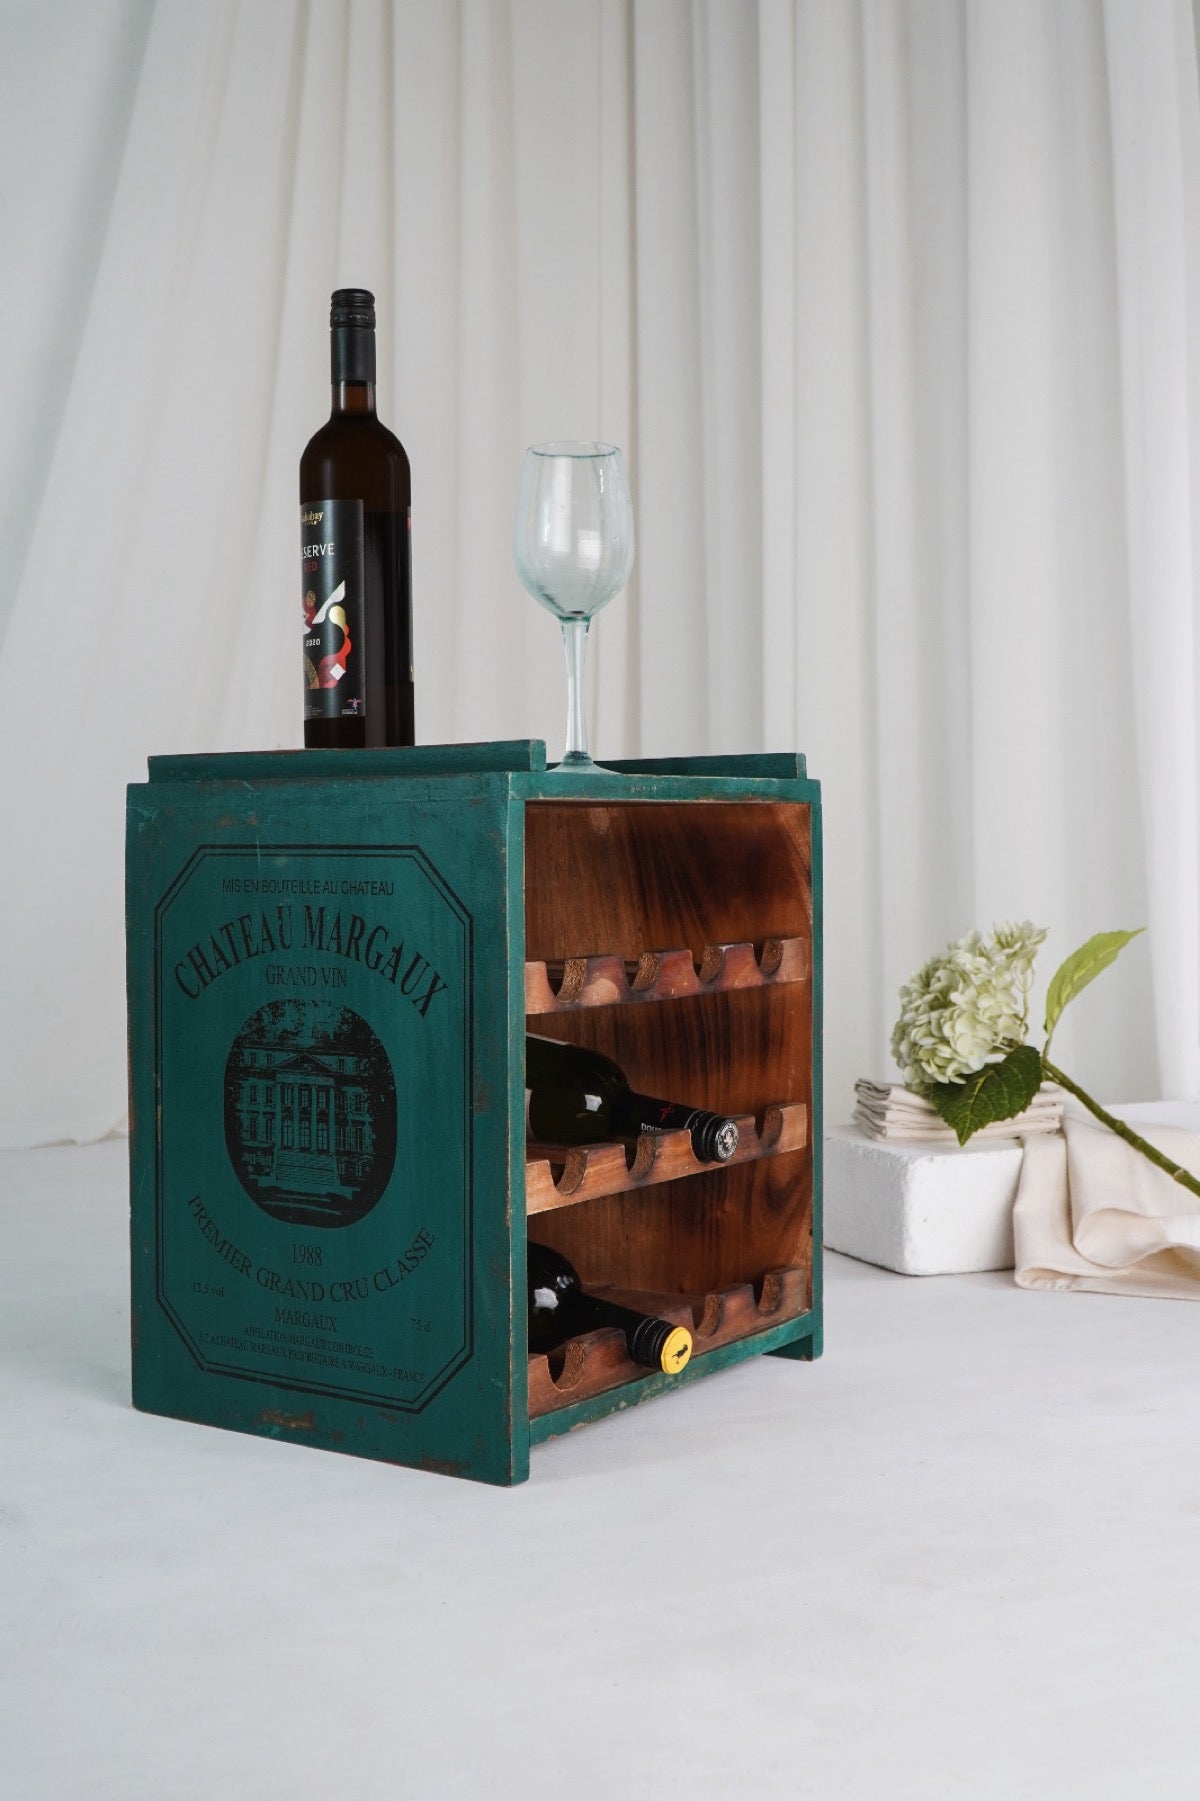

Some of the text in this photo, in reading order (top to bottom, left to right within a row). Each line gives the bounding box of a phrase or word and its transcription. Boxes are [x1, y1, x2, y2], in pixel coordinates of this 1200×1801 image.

[302, 543, 335, 559] SERVE
[222, 879, 394, 896] MIS EN BOUTEILLE AU CHATEAU
[173, 904, 448, 1018] CHATEAU MARGAUX
[264, 965, 346, 987] GRAND VIN
[187, 1195, 436, 1302] PREMIER GRAND CRU CLASSE
[291, 1243, 322, 1267] 1988
[275, 1307, 338, 1333] MARGAUX
